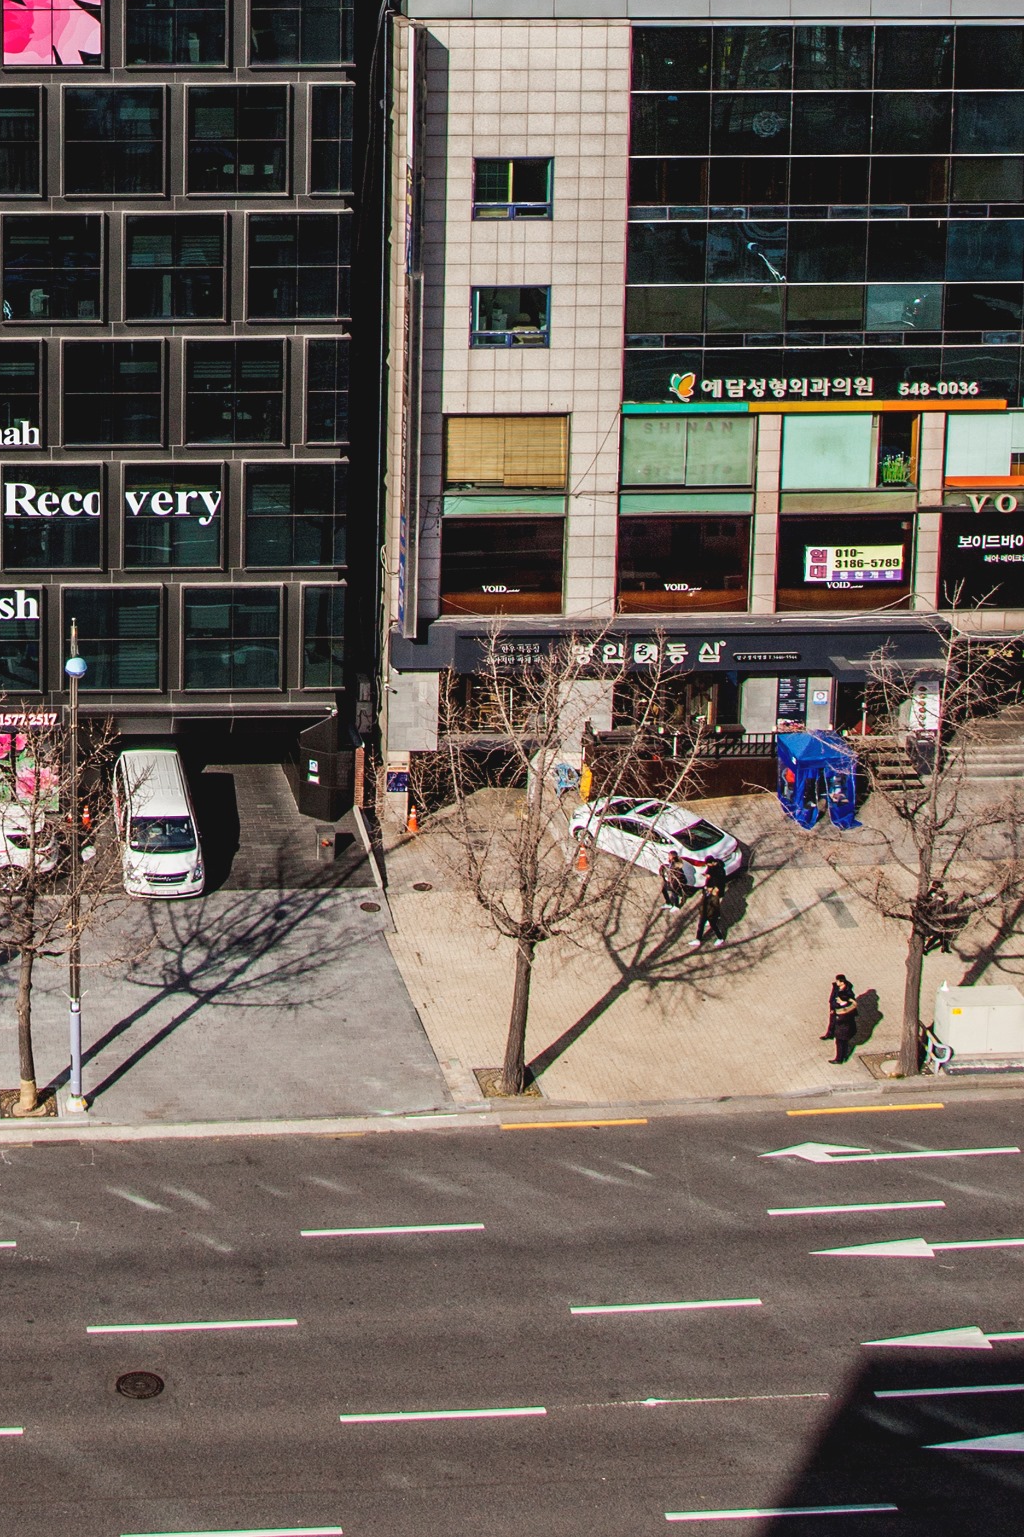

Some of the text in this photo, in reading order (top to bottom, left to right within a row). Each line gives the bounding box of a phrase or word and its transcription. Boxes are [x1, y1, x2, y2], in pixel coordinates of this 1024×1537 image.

[700, 376, 979, 398] 예담성형외과의원 548-0036
[835, 549, 864, 557] 010-
[835, 558, 900, 568] 3186-5789
[482, 585, 507, 593] VOID
[664, 583, 689, 591] VOID
[826, 581, 851, 589] VOID
